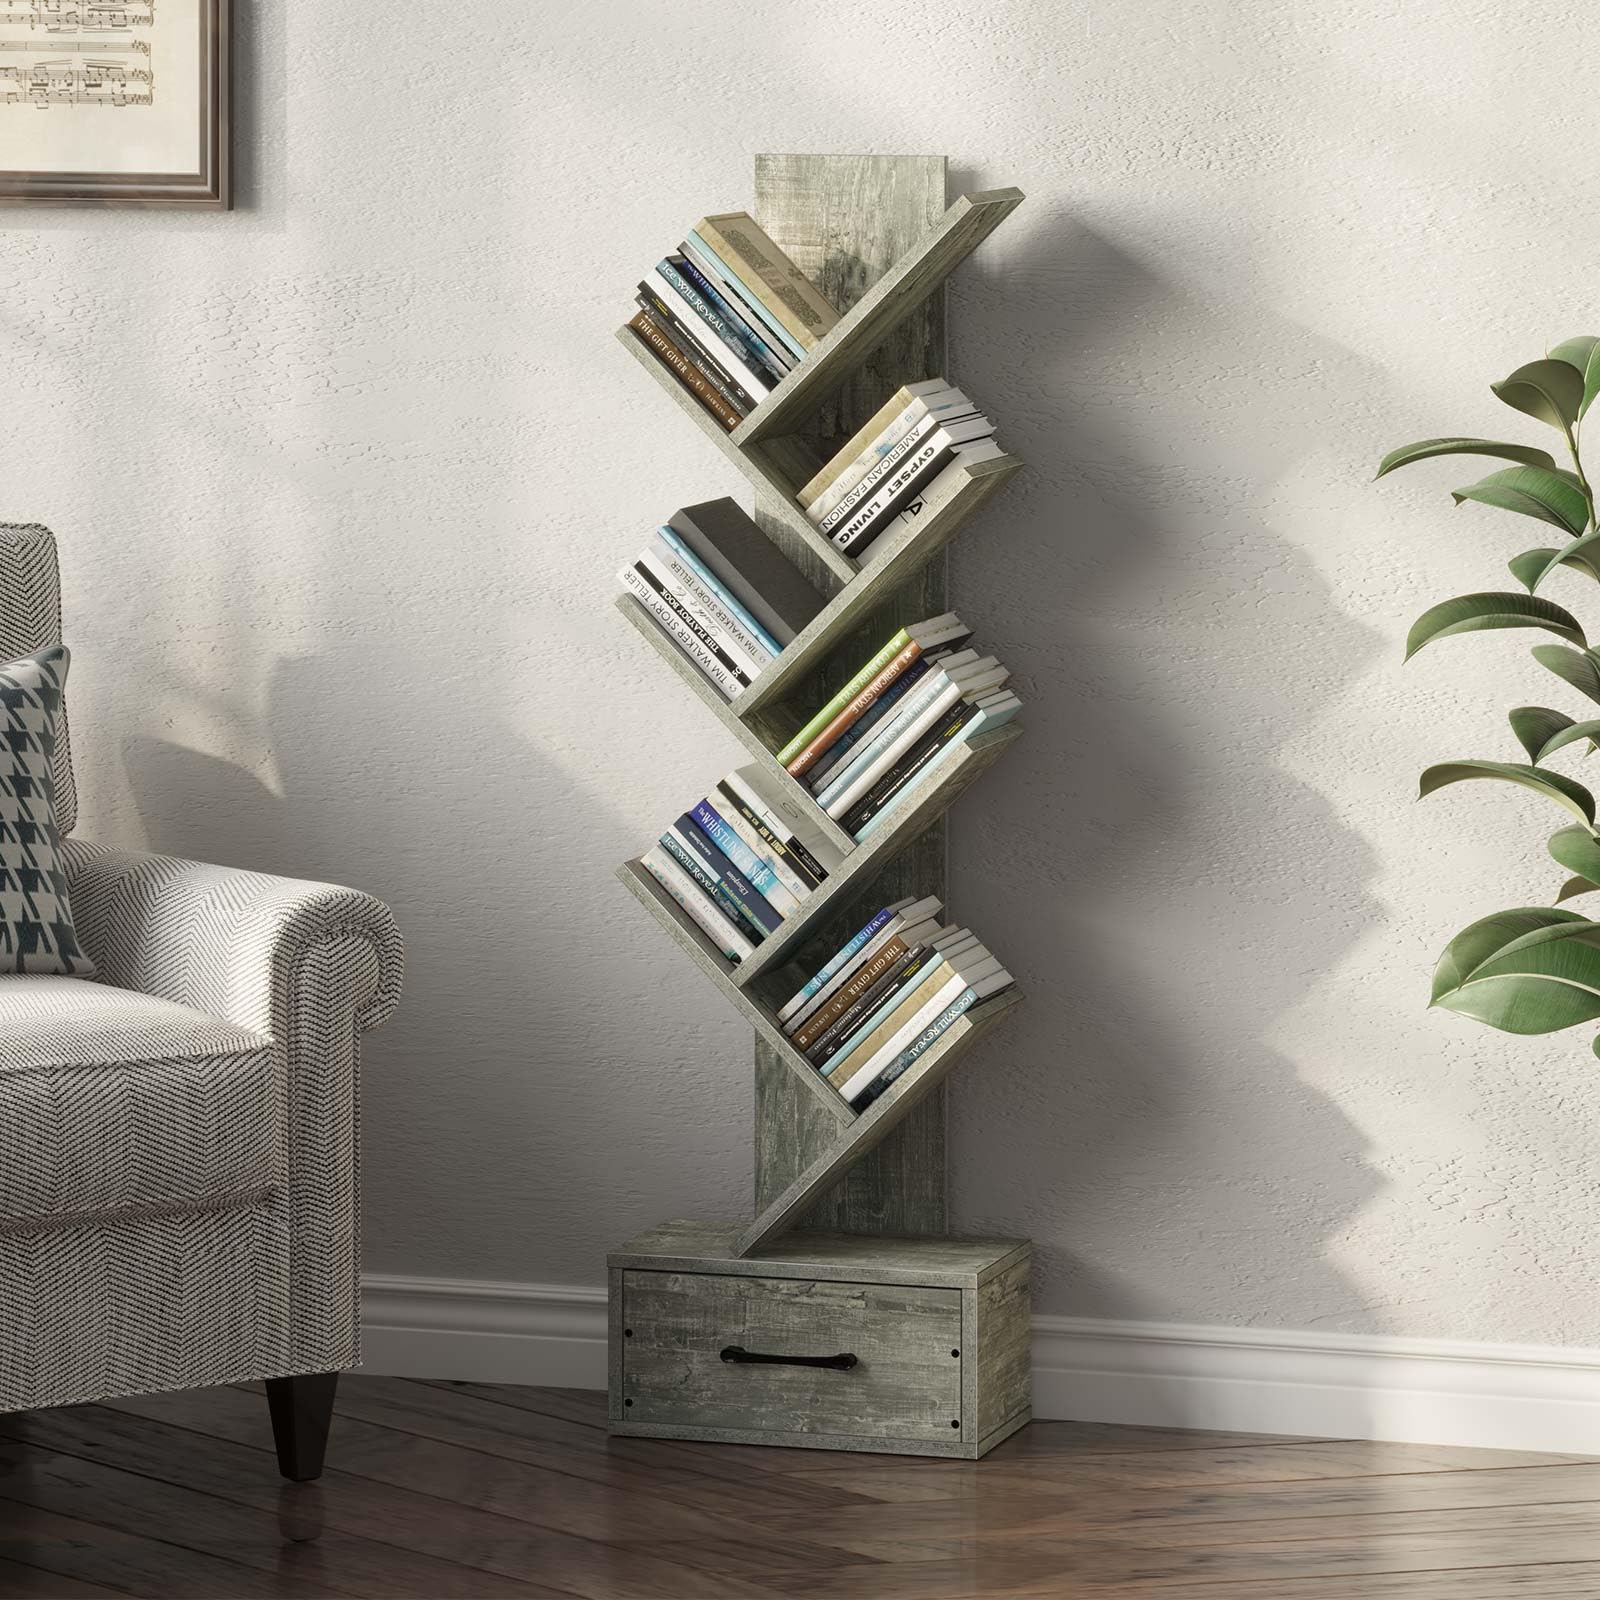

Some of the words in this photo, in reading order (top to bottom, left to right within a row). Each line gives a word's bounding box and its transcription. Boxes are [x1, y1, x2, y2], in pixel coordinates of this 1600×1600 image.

[636, 318, 654, 336] THE
[650, 333, 669, 352] GIFT
[664, 349, 688, 373] GIVER
[865, 426, 922, 483] AMERICAN
[884, 445, 936, 497] GYPSET
[820, 482, 868, 529] FASHION
[837, 500, 881, 544] LIVING
[622, 569, 654, 602] TELLER
[669, 559, 696, 587] TELLER
[648, 598, 680, 630] STORY
[658, 587, 680, 609] BOOK
[692, 585, 718, 612] STORY
[675, 606, 707, 639] PLAYBOY
[714, 609, 746, 642] WALKER
[675, 627, 714, 667] WALKER
[703, 636, 720, 653] THE
[742, 639, 759, 656] TIM
[709, 664, 729, 684] TIM
[855, 650, 890, 685] COUNTRY
[868, 661, 901, 694] AFRICAN
[836, 681, 860, 705] STYLE
[848, 689, 873, 714] STYLE
[867, 957, 886, 976] GIFT
[882, 943, 900, 960] THE
[847, 972, 870, 996] GIVER
